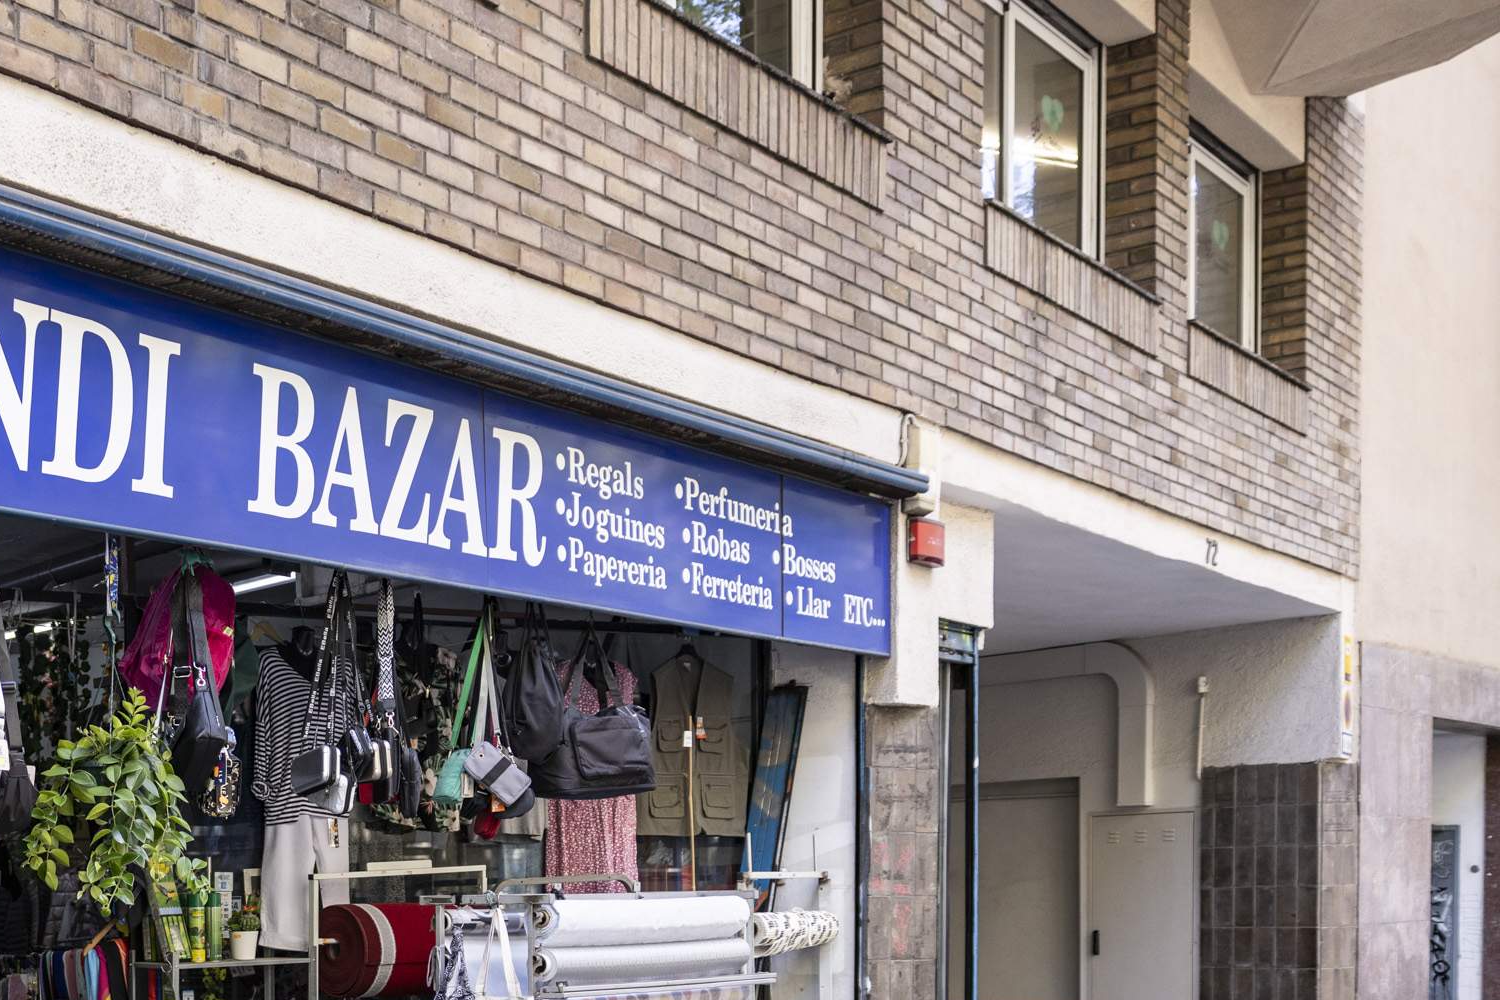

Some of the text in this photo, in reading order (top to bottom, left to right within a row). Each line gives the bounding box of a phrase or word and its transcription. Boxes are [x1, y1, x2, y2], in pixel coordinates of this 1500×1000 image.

[248, 361, 547, 568] BAZAR
[567, 446, 644, 500] Regals
[566, 492, 665, 549] Joguines
[684, 477, 793, 538] Perfumeria
[568, 537, 667, 590] Papereria
[692, 521, 750, 564] Robas
[782, 543, 836, 583] Bosses
[1206, 537, 1219, 567] 72
[692, 562, 773, 610] Ferreteria
[796, 586, 830, 619] Llar
